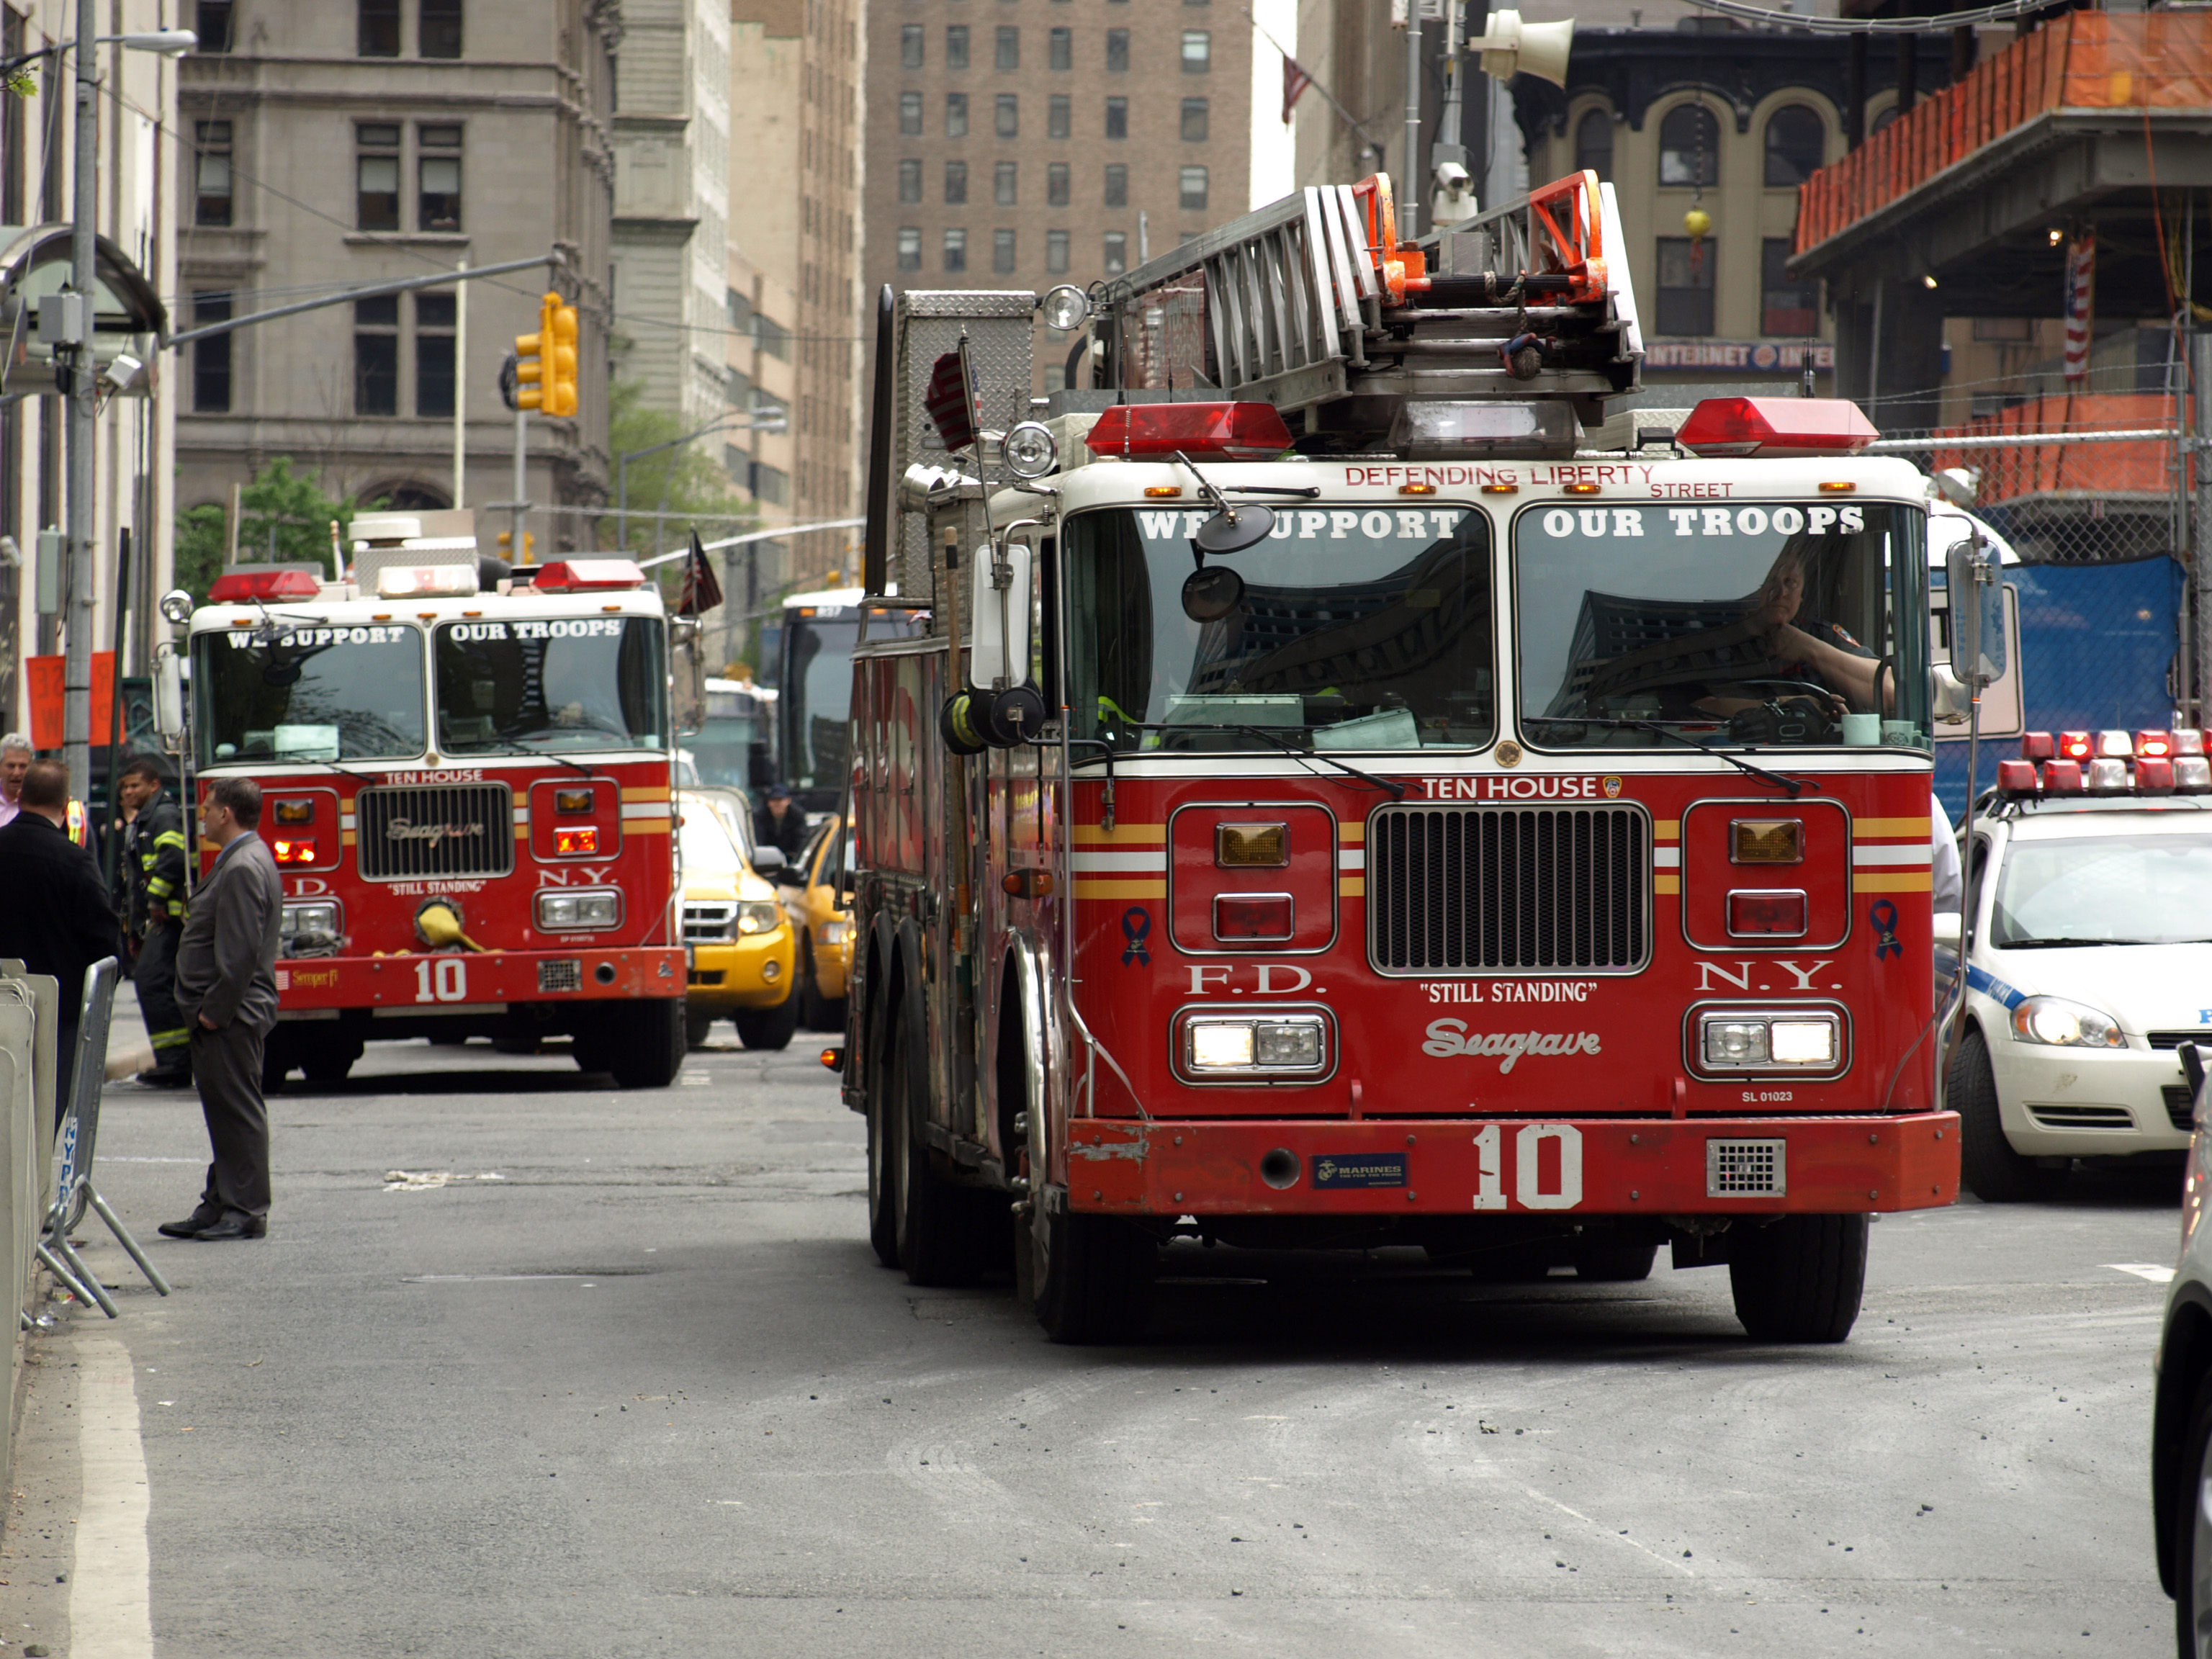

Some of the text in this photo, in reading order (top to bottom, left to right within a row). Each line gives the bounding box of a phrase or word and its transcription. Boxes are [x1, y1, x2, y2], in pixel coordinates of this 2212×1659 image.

[1645, 345, 1750, 367] INTERNET
[1345, 465, 1655, 486] DEFENDING LIBERTY
[1650, 482, 1733, 498] STREET
[1269, 511, 1460, 539] UPPORT
[1543, 506, 1865, 537] OUR TROOPS
[450, 619, 621, 641] OUR TROOPS
[385, 769, 483, 785] TEN HOUSE
[1422, 777, 1596, 799] TEN HOUSE
[292, 969, 329, 989] Semper
[415, 958, 467, 1003] 10
[1184, 964, 1327, 994] F.D.
[1694, 960, 1843, 991] N.Y.
[1420, 982, 1598, 1003] "STILL STANDING"
[1421, 1017, 1601, 1074] Seagrave
[1742, 1091, 1793, 1102] SL 01023
[58, 1126, 76, 1205] NYPD
[1339, 1166, 1401, 1174] MARINES
[1473, 1124, 1583, 1210] 10
